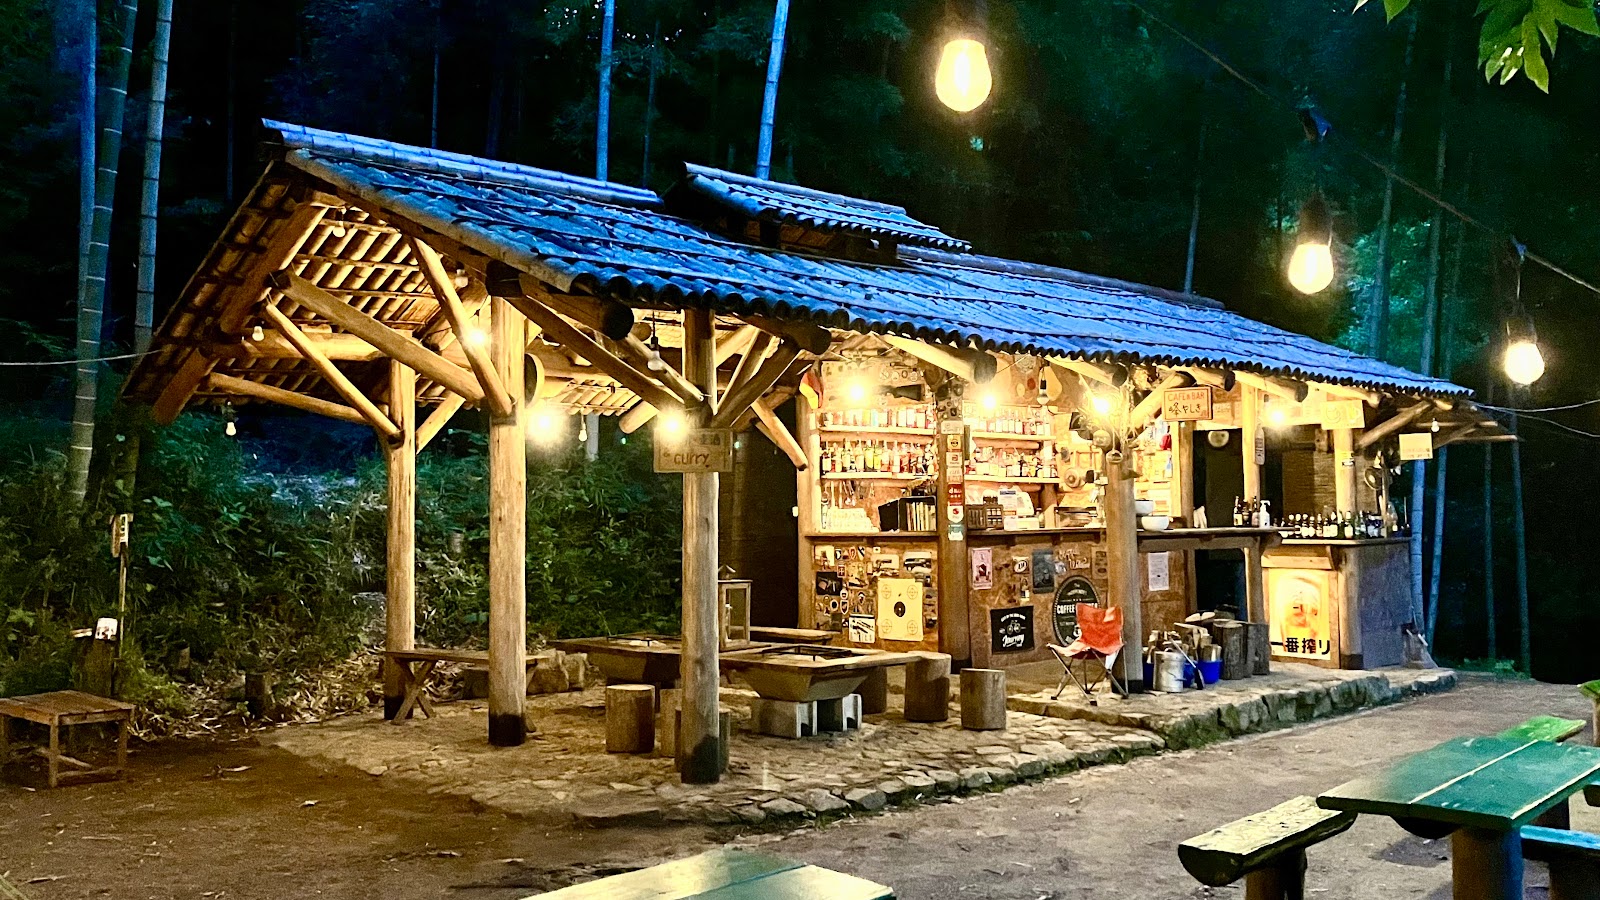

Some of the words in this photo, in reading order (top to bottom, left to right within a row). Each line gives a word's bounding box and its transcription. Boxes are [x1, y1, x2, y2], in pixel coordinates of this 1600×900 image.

[1191, 391, 1205, 400] BAR
[674, 452, 710, 465] curry
[1056, 604, 1075, 615] COFFEE
[1270, 637, 1331, 655] 一番搾り
